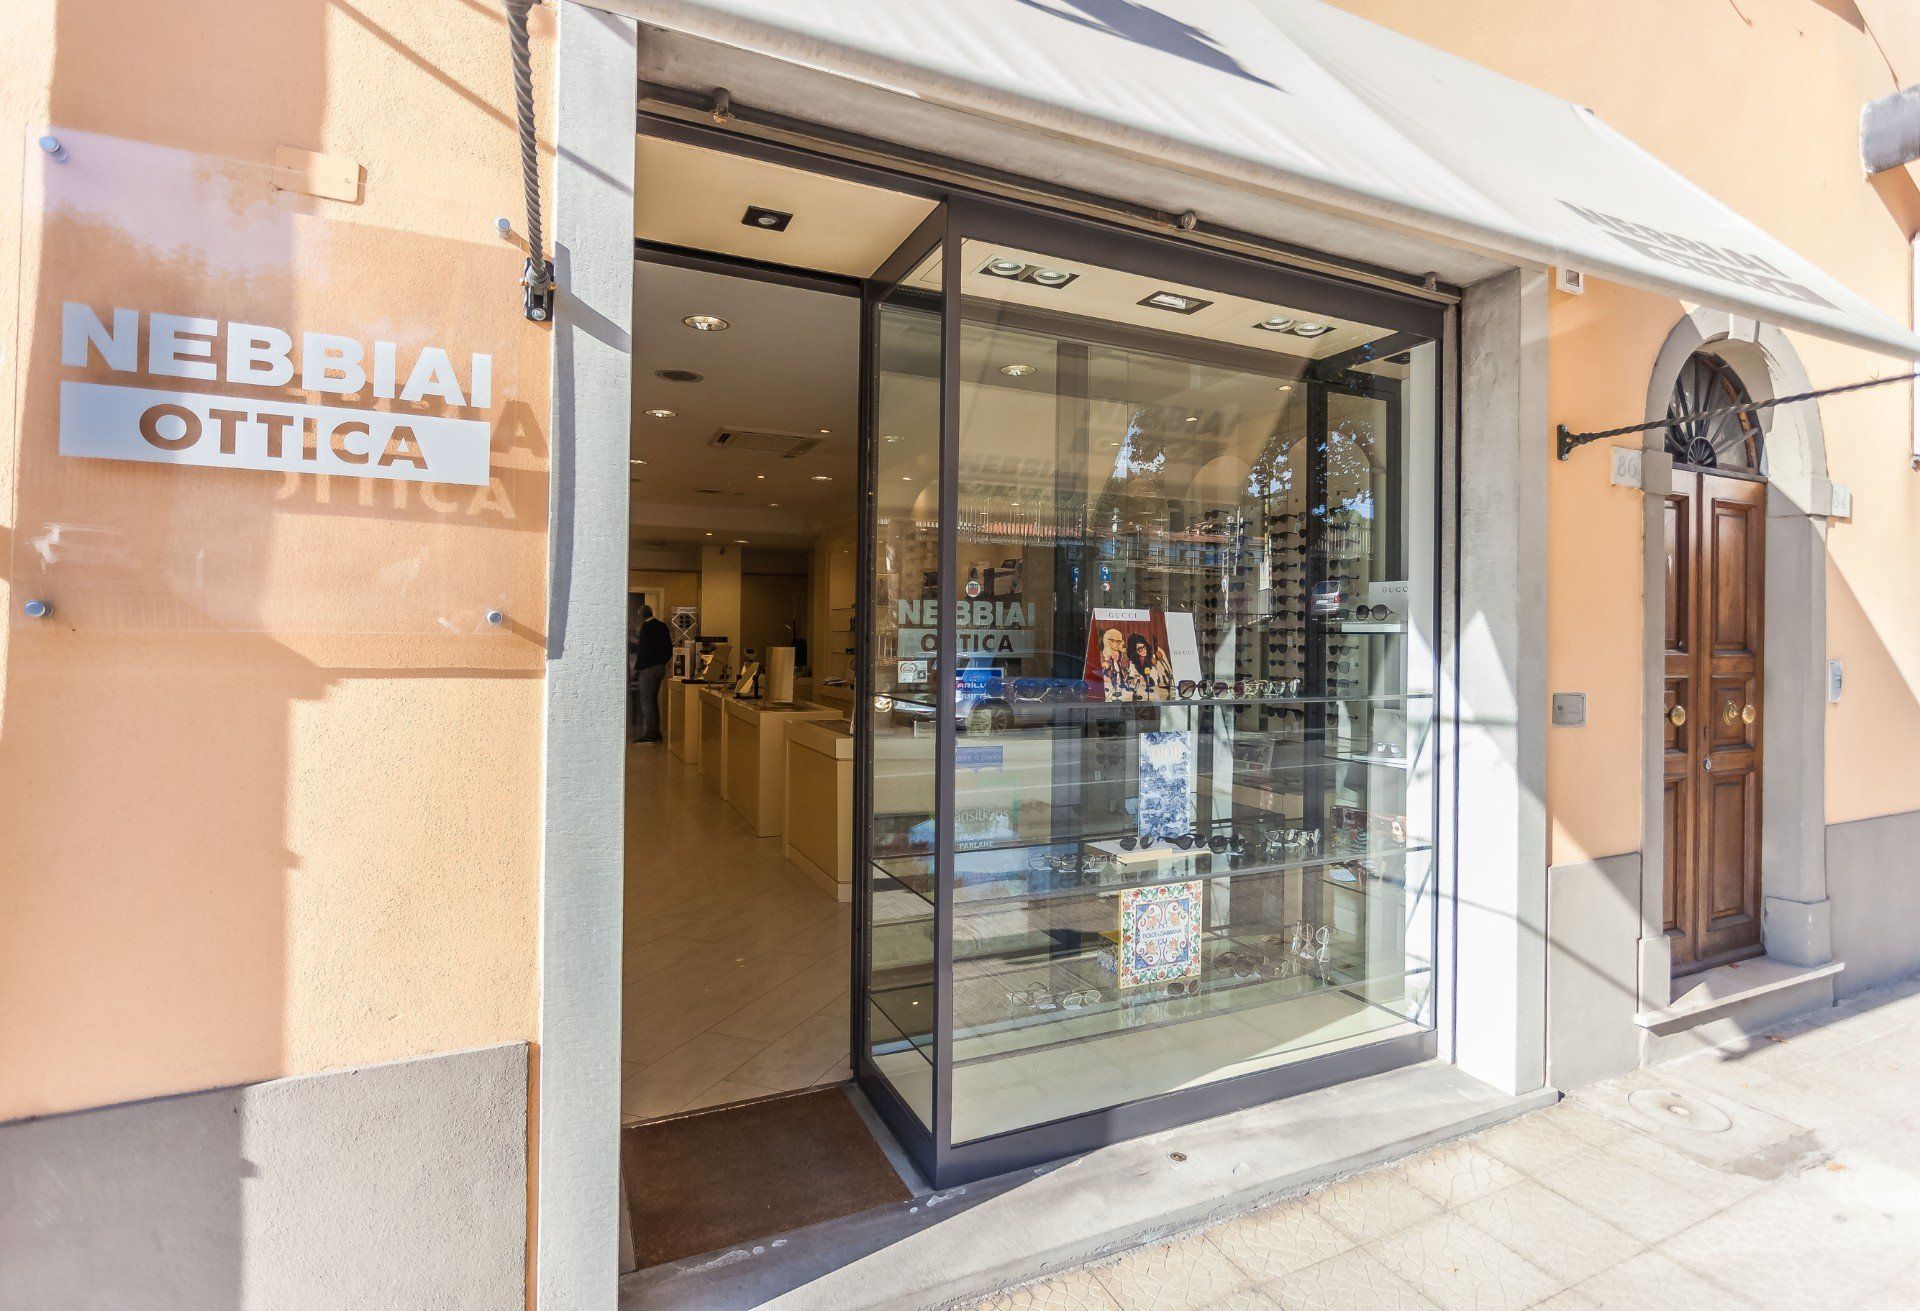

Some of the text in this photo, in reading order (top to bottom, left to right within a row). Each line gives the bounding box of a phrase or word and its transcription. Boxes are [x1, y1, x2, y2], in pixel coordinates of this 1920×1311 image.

[61, 301, 493, 409] NEBBIAI
[139, 403, 429, 470] OTTICA
[1616, 455, 1637, 478] 86
[1381, 586, 1408, 594] GUCC
[920, 633, 1014, 653] OTICA
